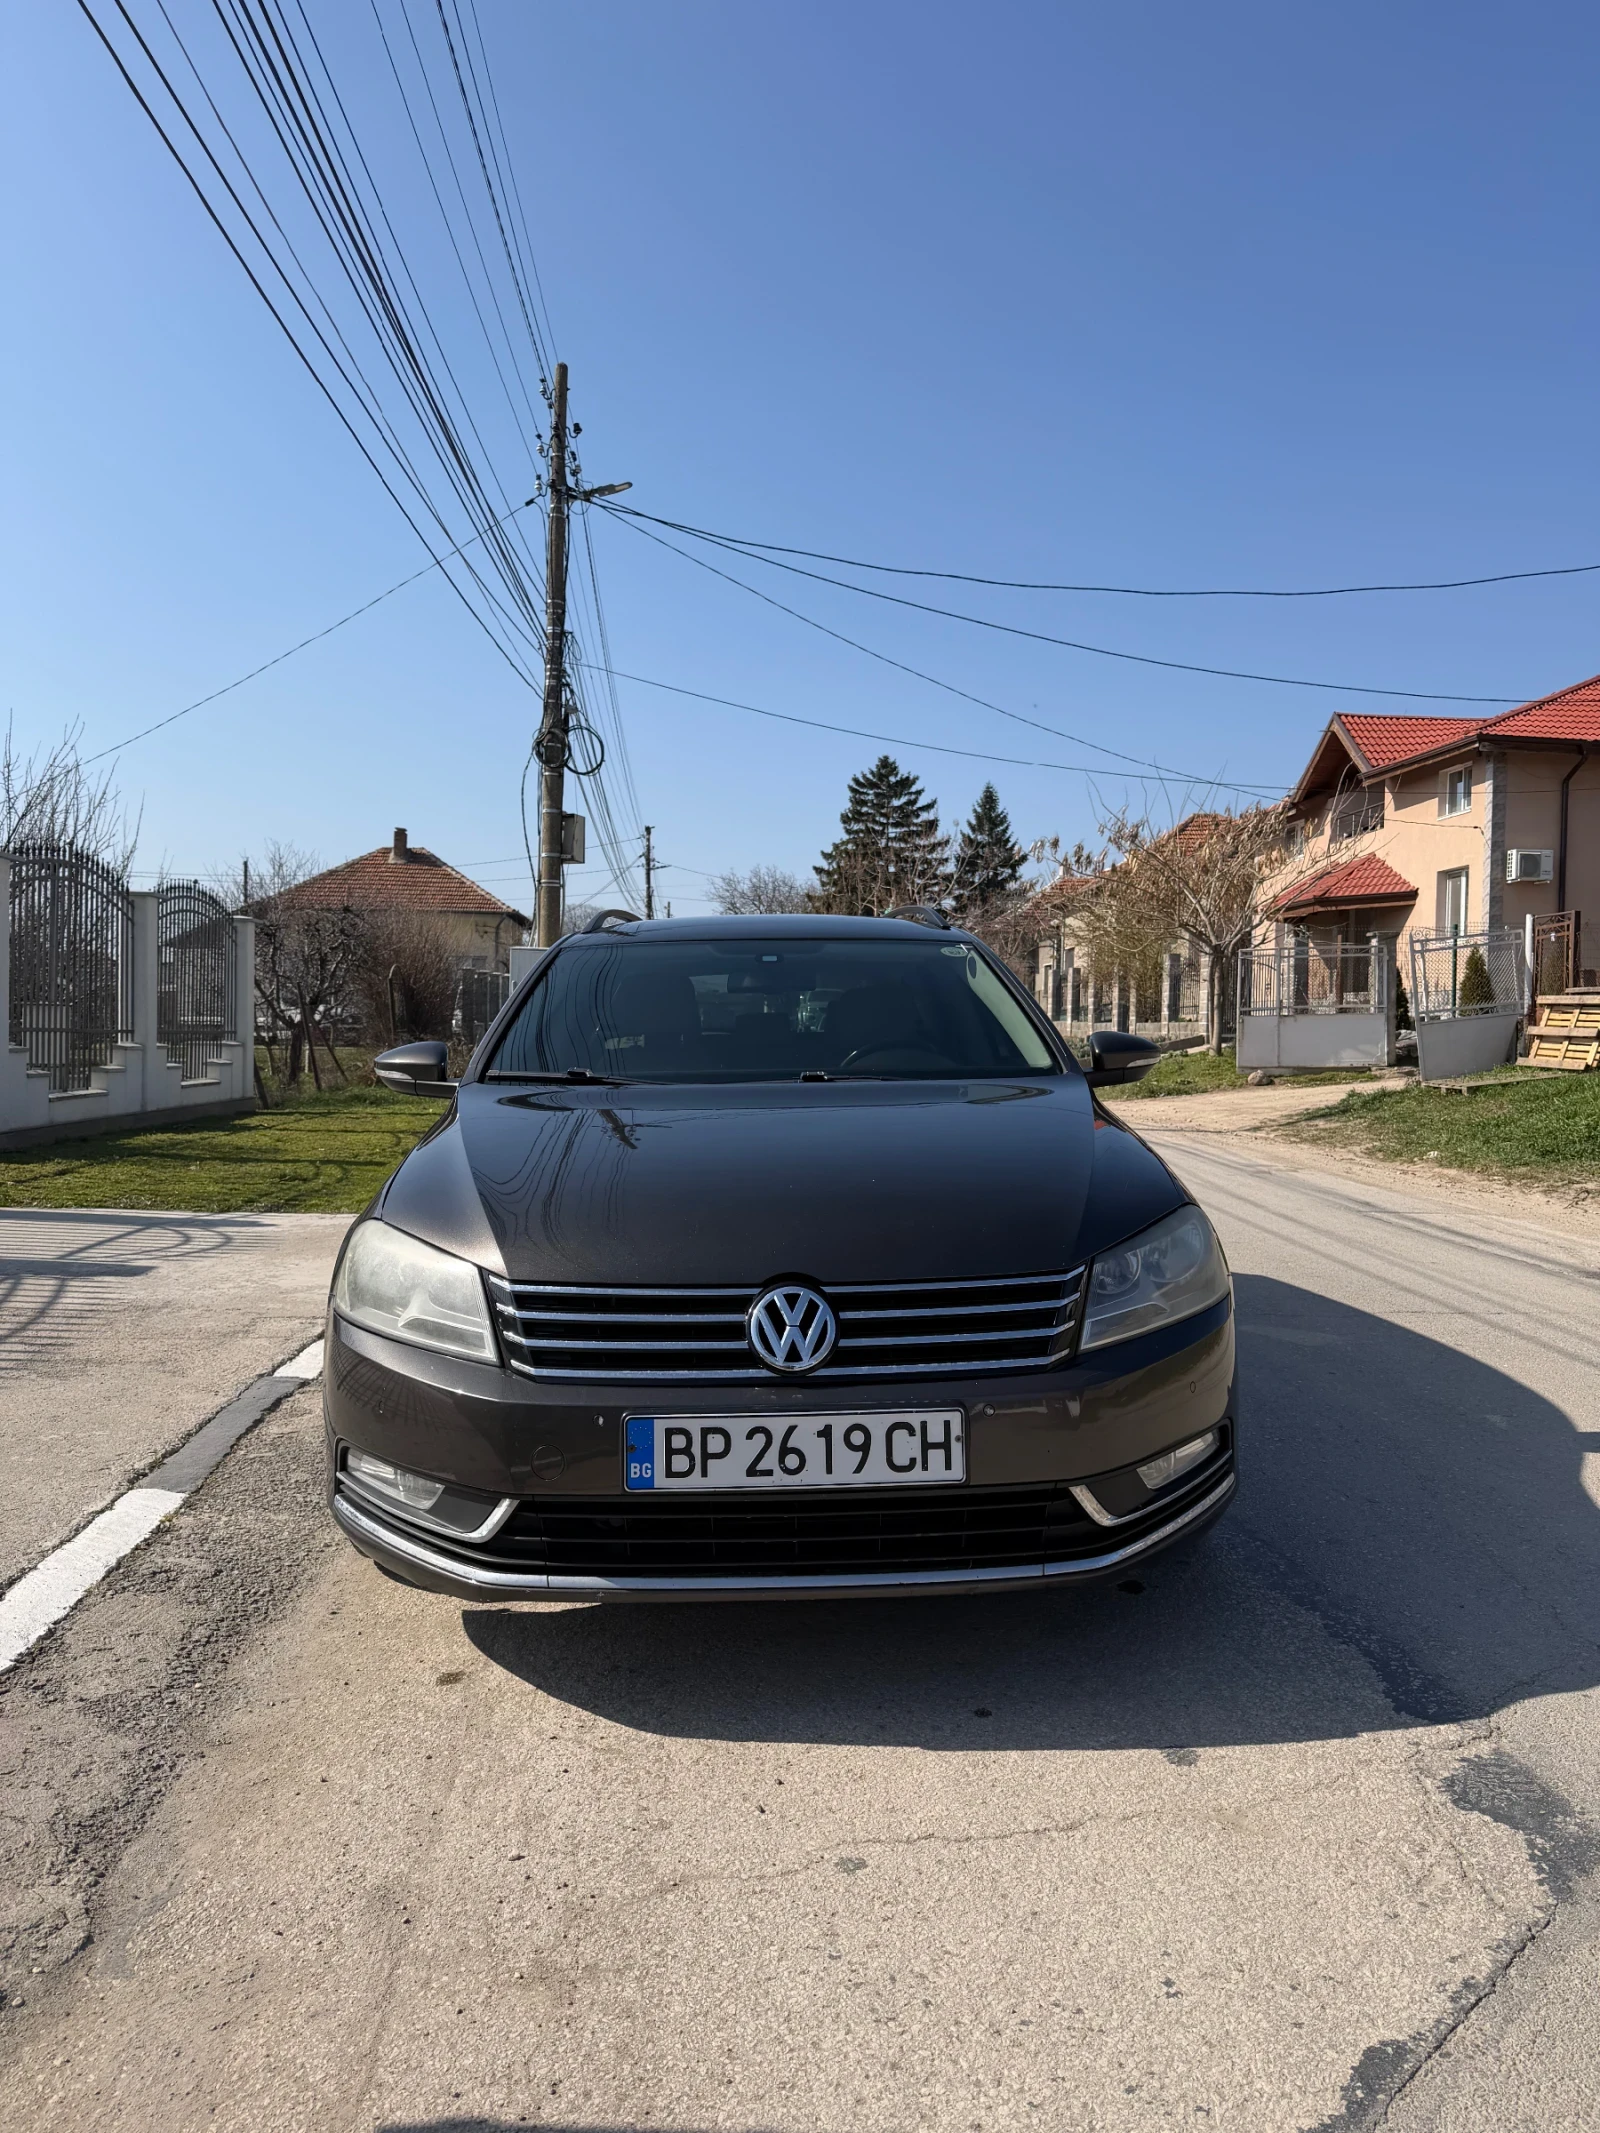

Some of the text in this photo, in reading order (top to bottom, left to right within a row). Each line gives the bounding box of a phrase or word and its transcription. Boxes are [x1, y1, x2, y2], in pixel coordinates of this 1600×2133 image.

[753, 1287, 833, 1368] VW
[630, 1462, 652, 1478] BG
[664, 1420, 952, 1478] BP 2619 CH
